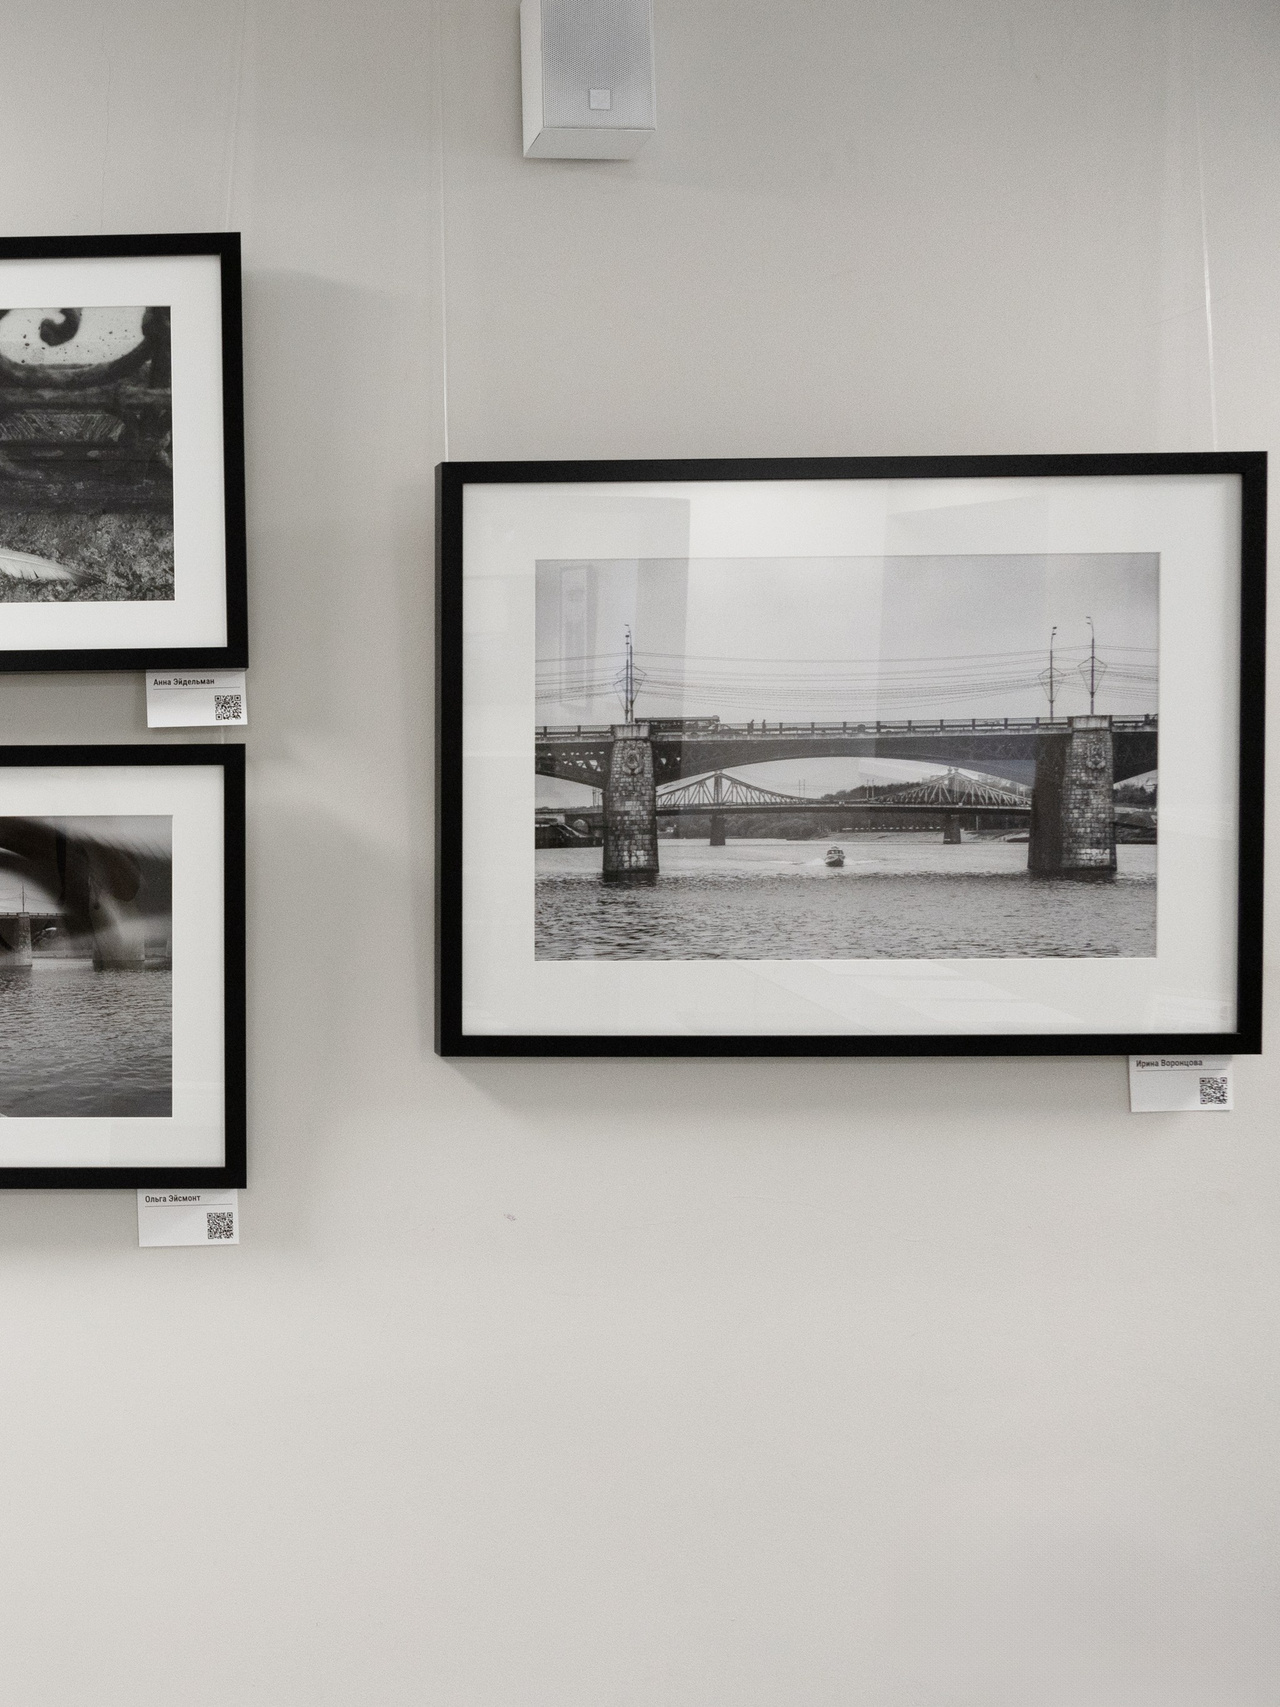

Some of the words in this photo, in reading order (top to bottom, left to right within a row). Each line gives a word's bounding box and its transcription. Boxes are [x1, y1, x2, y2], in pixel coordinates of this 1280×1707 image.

[153, 678, 171, 686] Анна
[173, 677, 215, 686] Эйдельман
[1136, 1060, 1159, 1068] Ирина
[1161, 1059, 1203, 1068] Воронцова
[145, 1195, 167, 1203] Ольга
[168, 1194, 201, 1202] Эйсмонт
